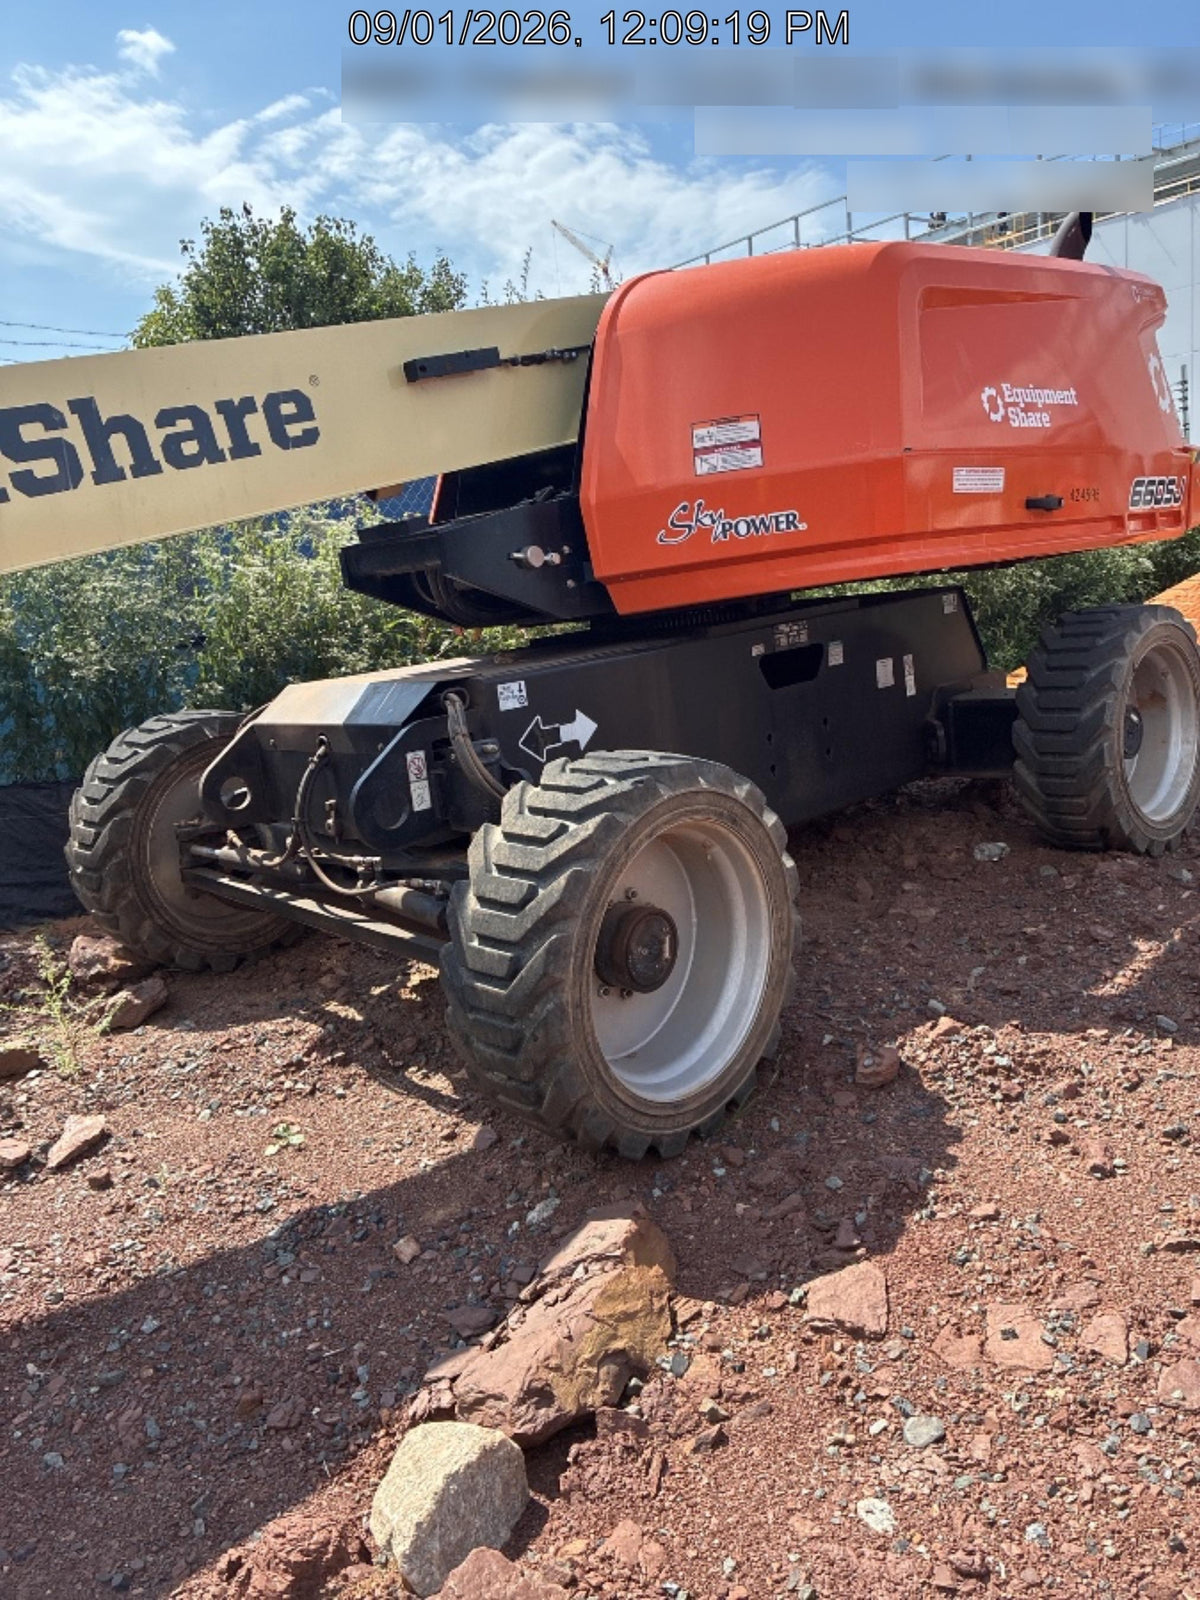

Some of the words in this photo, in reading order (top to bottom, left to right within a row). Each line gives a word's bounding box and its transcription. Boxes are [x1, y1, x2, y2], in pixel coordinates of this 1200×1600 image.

[1001, 383, 1078, 408] Equipment
[1008, 406, 1051, 428] Share
[0, 389, 320, 502] Share
